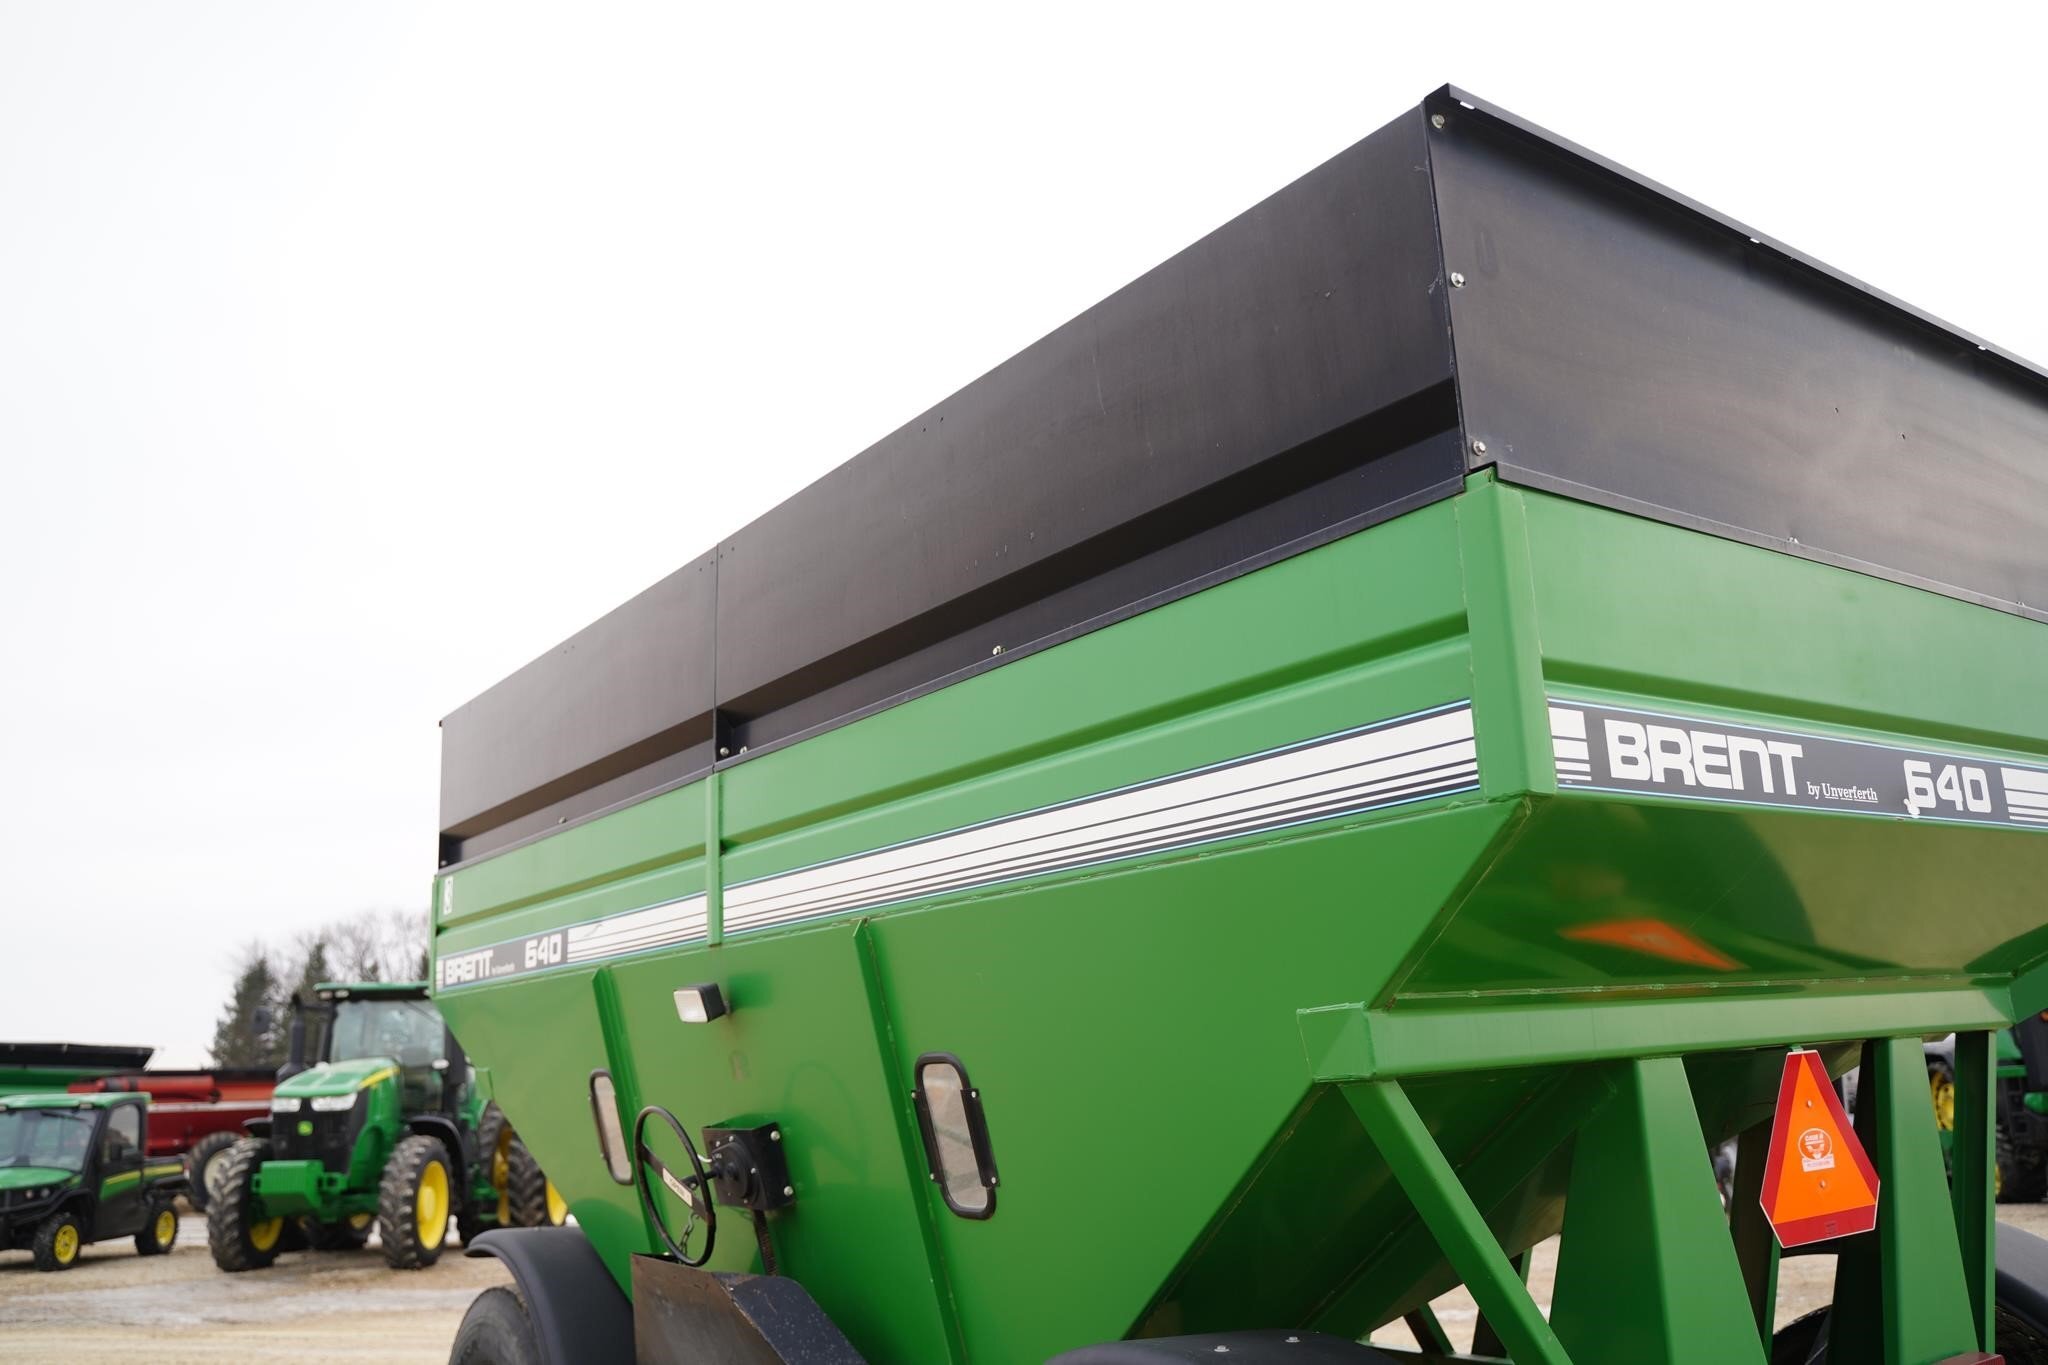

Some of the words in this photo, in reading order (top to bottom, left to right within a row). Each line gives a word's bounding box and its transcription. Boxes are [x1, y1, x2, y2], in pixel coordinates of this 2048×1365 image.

[1604, 719, 1803, 795] BRENT
[1806, 781, 1820, 800] by
[1822, 783, 1879, 803] Unverferth
[1904, 759, 1992, 814] 640
[445, 949, 494, 985] BRENT
[525, 933, 562, 969] 640
